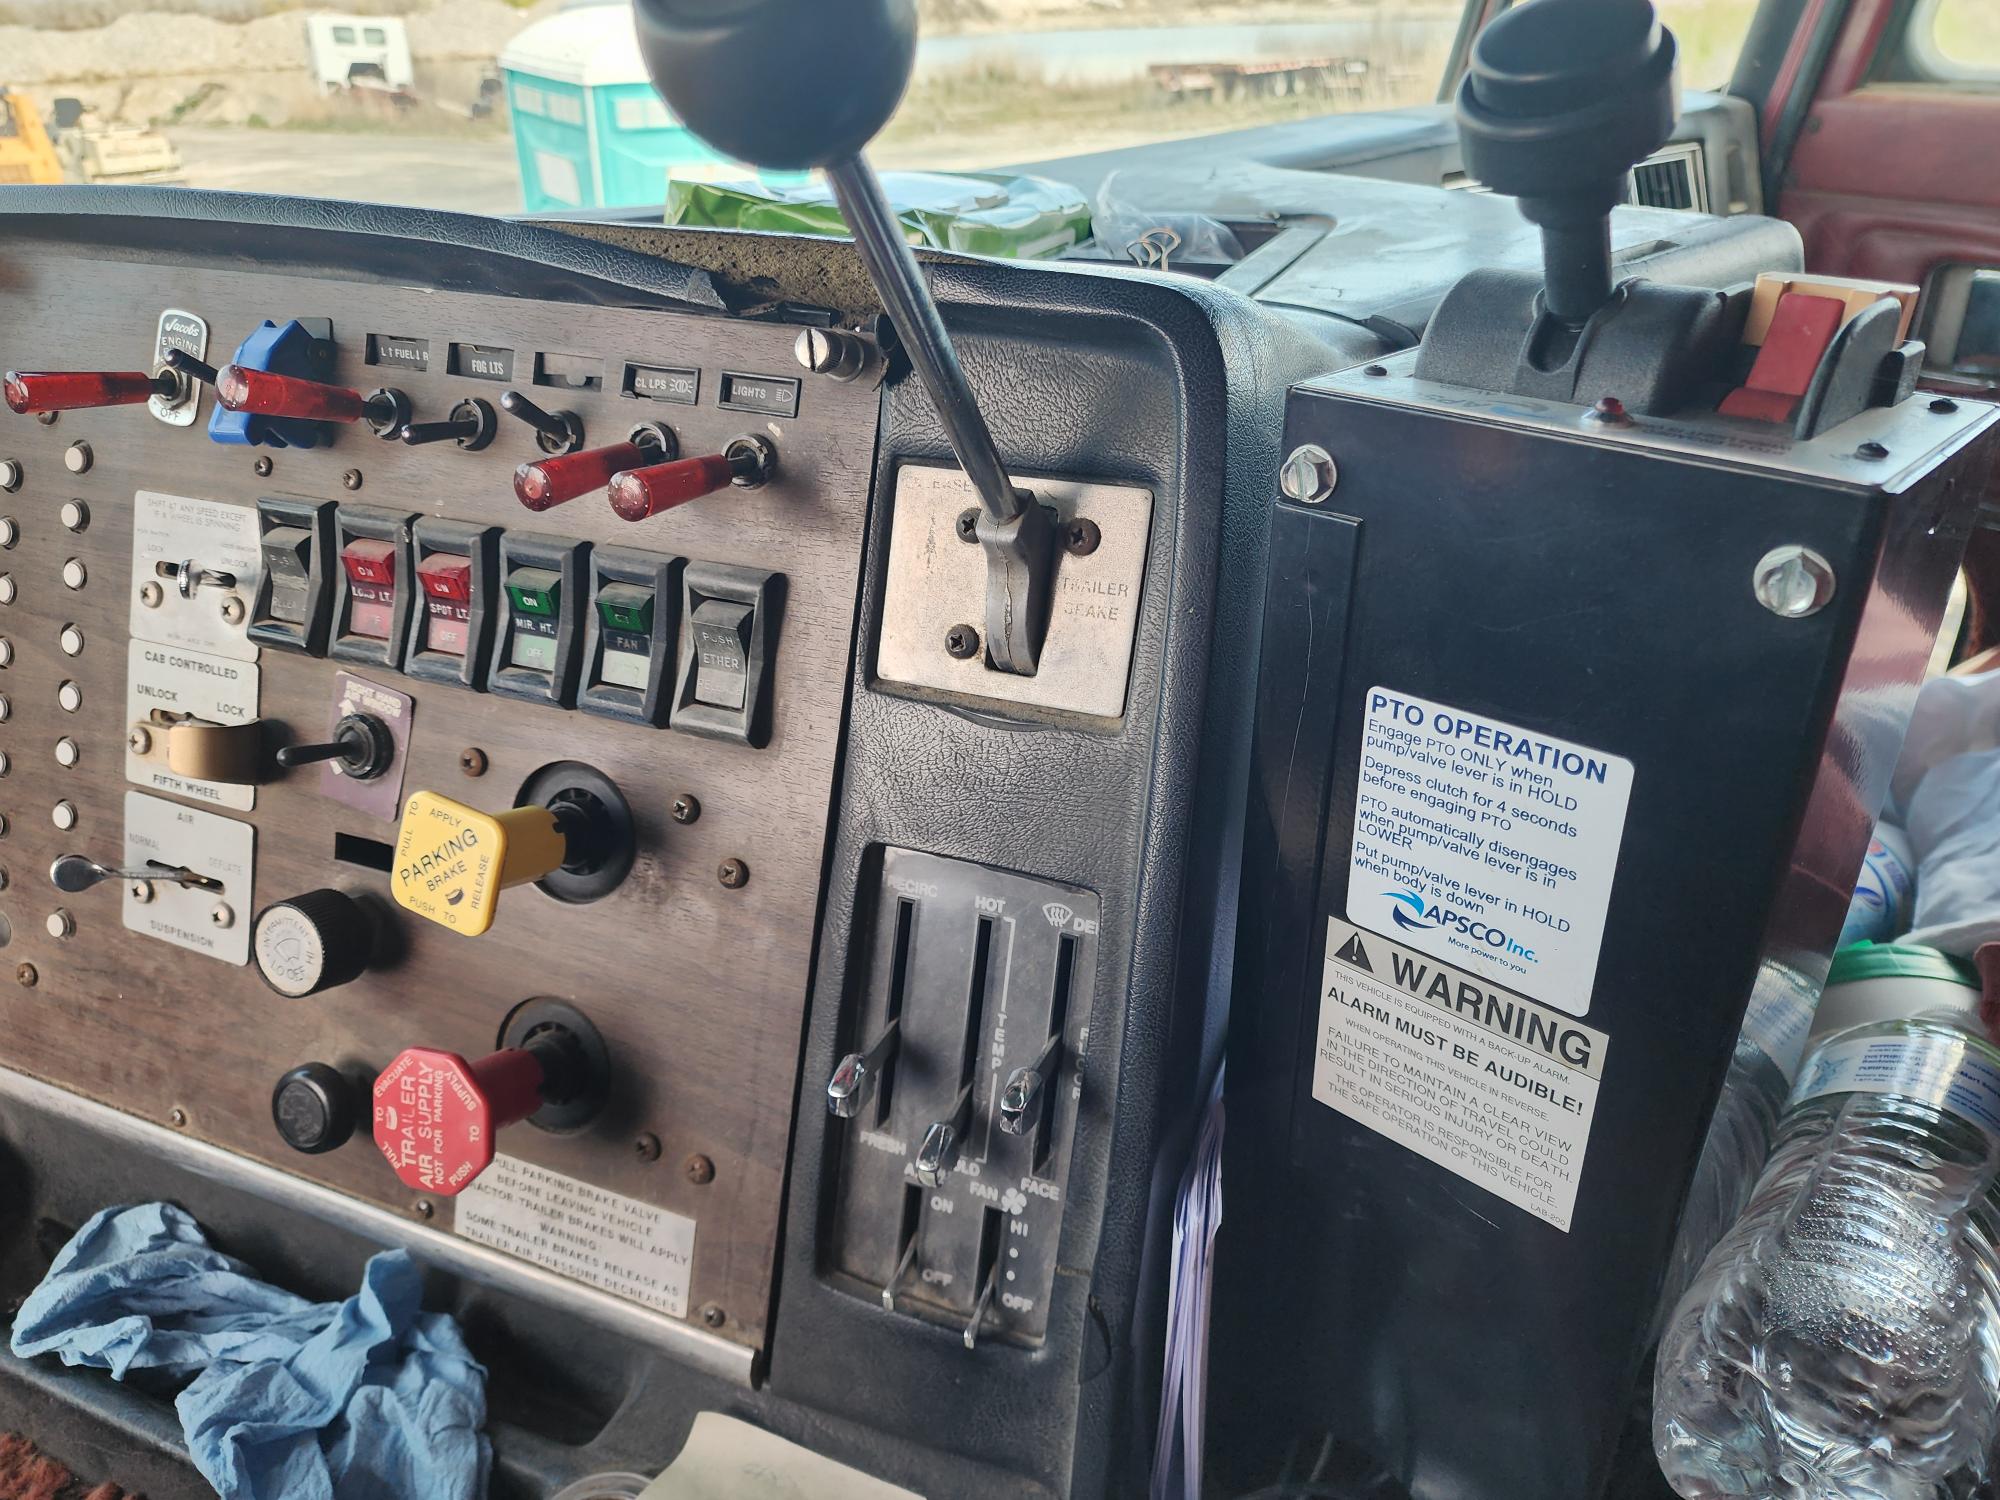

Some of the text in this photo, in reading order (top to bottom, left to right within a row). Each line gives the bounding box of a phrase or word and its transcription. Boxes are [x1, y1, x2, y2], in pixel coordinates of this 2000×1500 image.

[162, 336, 198, 354] ENGINE
[165, 318, 200, 336] Jacobs
[395, 348, 415, 360] FUEL
[472, 360, 504, 374] FOG LTS
[649, 378, 666, 390] LPS
[732, 385, 766, 399] LIGHTS
[430, 604, 453, 616] SPOT
[516, 618, 536, 630] MIR.
[524, 596, 538, 606] ON
[145, 651, 238, 680] CAB CONTROLLED
[616, 636, 638, 650] FAN
[704, 653, 739, 669] ETHER
[137, 684, 178, 702] UNLOCK
[217, 702, 245, 718] LOCK
[1368, 718, 1553, 788] Engage PTO ONLY when
[1371, 693, 1607, 783] PTO OPERATION
[154, 774, 221, 800] FIFTH WHEEL
[1364, 754, 1577, 837] Depress clutch for 4 seconds
[1366, 735, 1577, 811] pump/valve lever is in HOLD
[177, 812, 194, 824] AIR
[1362, 769, 1511, 831] before engaging PTO
[401, 801, 462, 857] PULL TO APPLY
[1358, 819, 1412, 850] LOWER
[1358, 808, 1556, 889] when pump/valve lever is in
[1360, 793, 1576, 880] PTO automatically disengages
[400, 828, 478, 887] PARKING
[426, 860, 468, 892] BRAKE
[409, 854, 490, 924] PUSH TO RELEASE
[888, 878, 938, 898] RECIRC
[975, 896, 1006, 913] HOT
[1354, 855, 1484, 914] when body is down
[1355, 840, 1570, 932] Put pump/valve lever in HOLD
[150, 920, 214, 948] SUSPENSION
[1423, 904, 1538, 963] APSCO Inc.
[1447, 935, 1527, 974] More power to you
[1334, 969, 1568, 1084] THIS VEHICLE IS EQUIPPED WITH A BACK-UP ALARM.
[1391, 952, 1590, 1068] WARNING
[992, 1012, 1007, 1070] TEMP
[1327, 986, 1582, 1115] ALARM MUST BE AUDIBLE!
[1327, 1025, 1572, 1152] FAILURE TO MAINTAIN A CLEAR VIEW
[1344, 1016, 1549, 1122] WHEN OPERATING THIS VEHICLE IN REVERSE.
[376, 1107, 384, 1122] TO
[401, 1076, 416, 1167] TRAILER
[418, 1062, 434, 1188] AIR SUPPLY
[1319, 1047, 1517, 1155] RESULT IN SERIOUS INJURY OR
[1325, 1038, 1569, 1165] IN THE DIRECTION OF TRAVEL COULD
[434, 1070, 444, 1184] NOT FOR PARKING
[444, 1071, 480, 1186] PUSH TO SUPPLY
[860, 1130, 906, 1156] FRESH
[1327, 1080, 1498, 1177] THE SAFE OPERATION OF THIS
[1334, 1072, 1552, 1192] THE OPERATOR IS RESPONSIBLE FOR
[496, 1173, 651, 1236] BEFORE LEAVING VEHICLE
[521, 1166, 659, 1223] PARKING BRAKE VALVE
[930, 1196, 954, 1214] ON
[970, 1181, 998, 1201] FAN
[1020, 1178, 1060, 1201] FACE
[465, 1210, 655, 1287] SOME TRAILER BRAKES RELEASE
[567, 1214, 688, 1265] BRAKES WILL APPLY
[1010, 1220, 1028, 1238] HI
[922, 1268, 953, 1287] OFF
[1002, 1292, 1034, 1314] OFF
